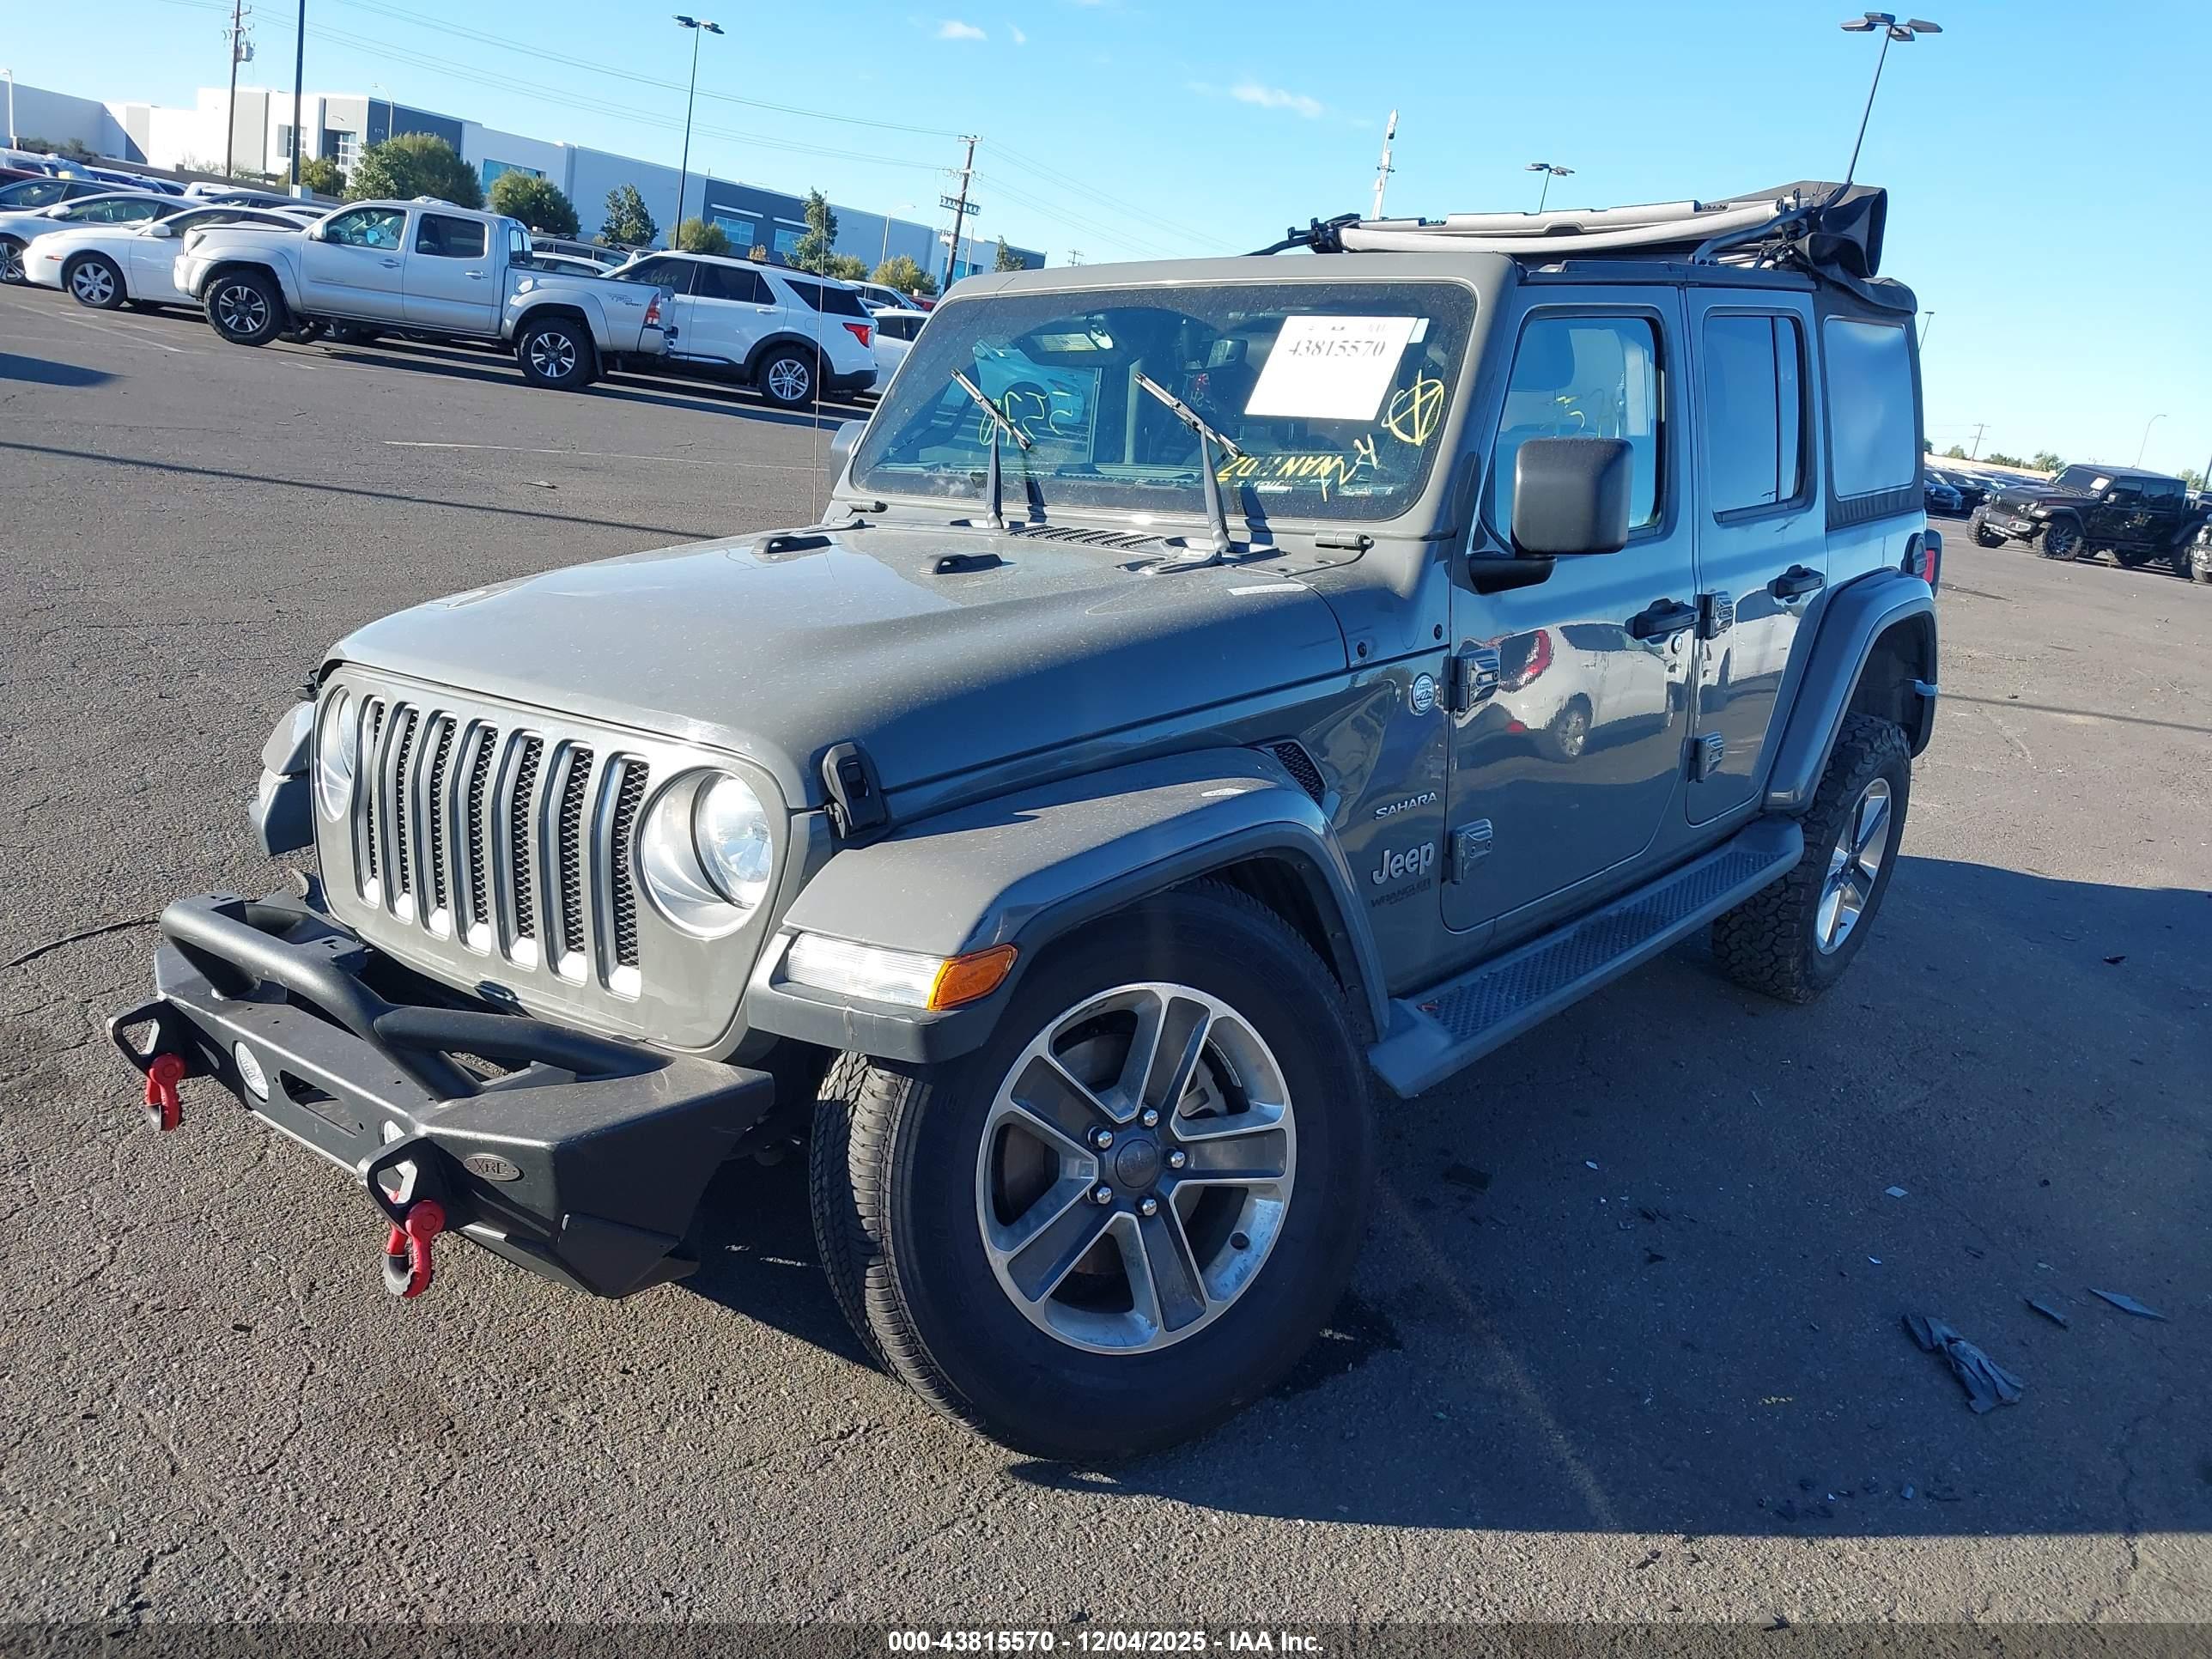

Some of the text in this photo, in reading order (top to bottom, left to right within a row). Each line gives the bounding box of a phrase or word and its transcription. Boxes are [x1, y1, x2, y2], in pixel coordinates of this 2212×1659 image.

[1289, 339, 1385, 356] 43815570
[1375, 792, 1437, 819] SAHARA
[1372, 842, 1435, 884] Jeep
